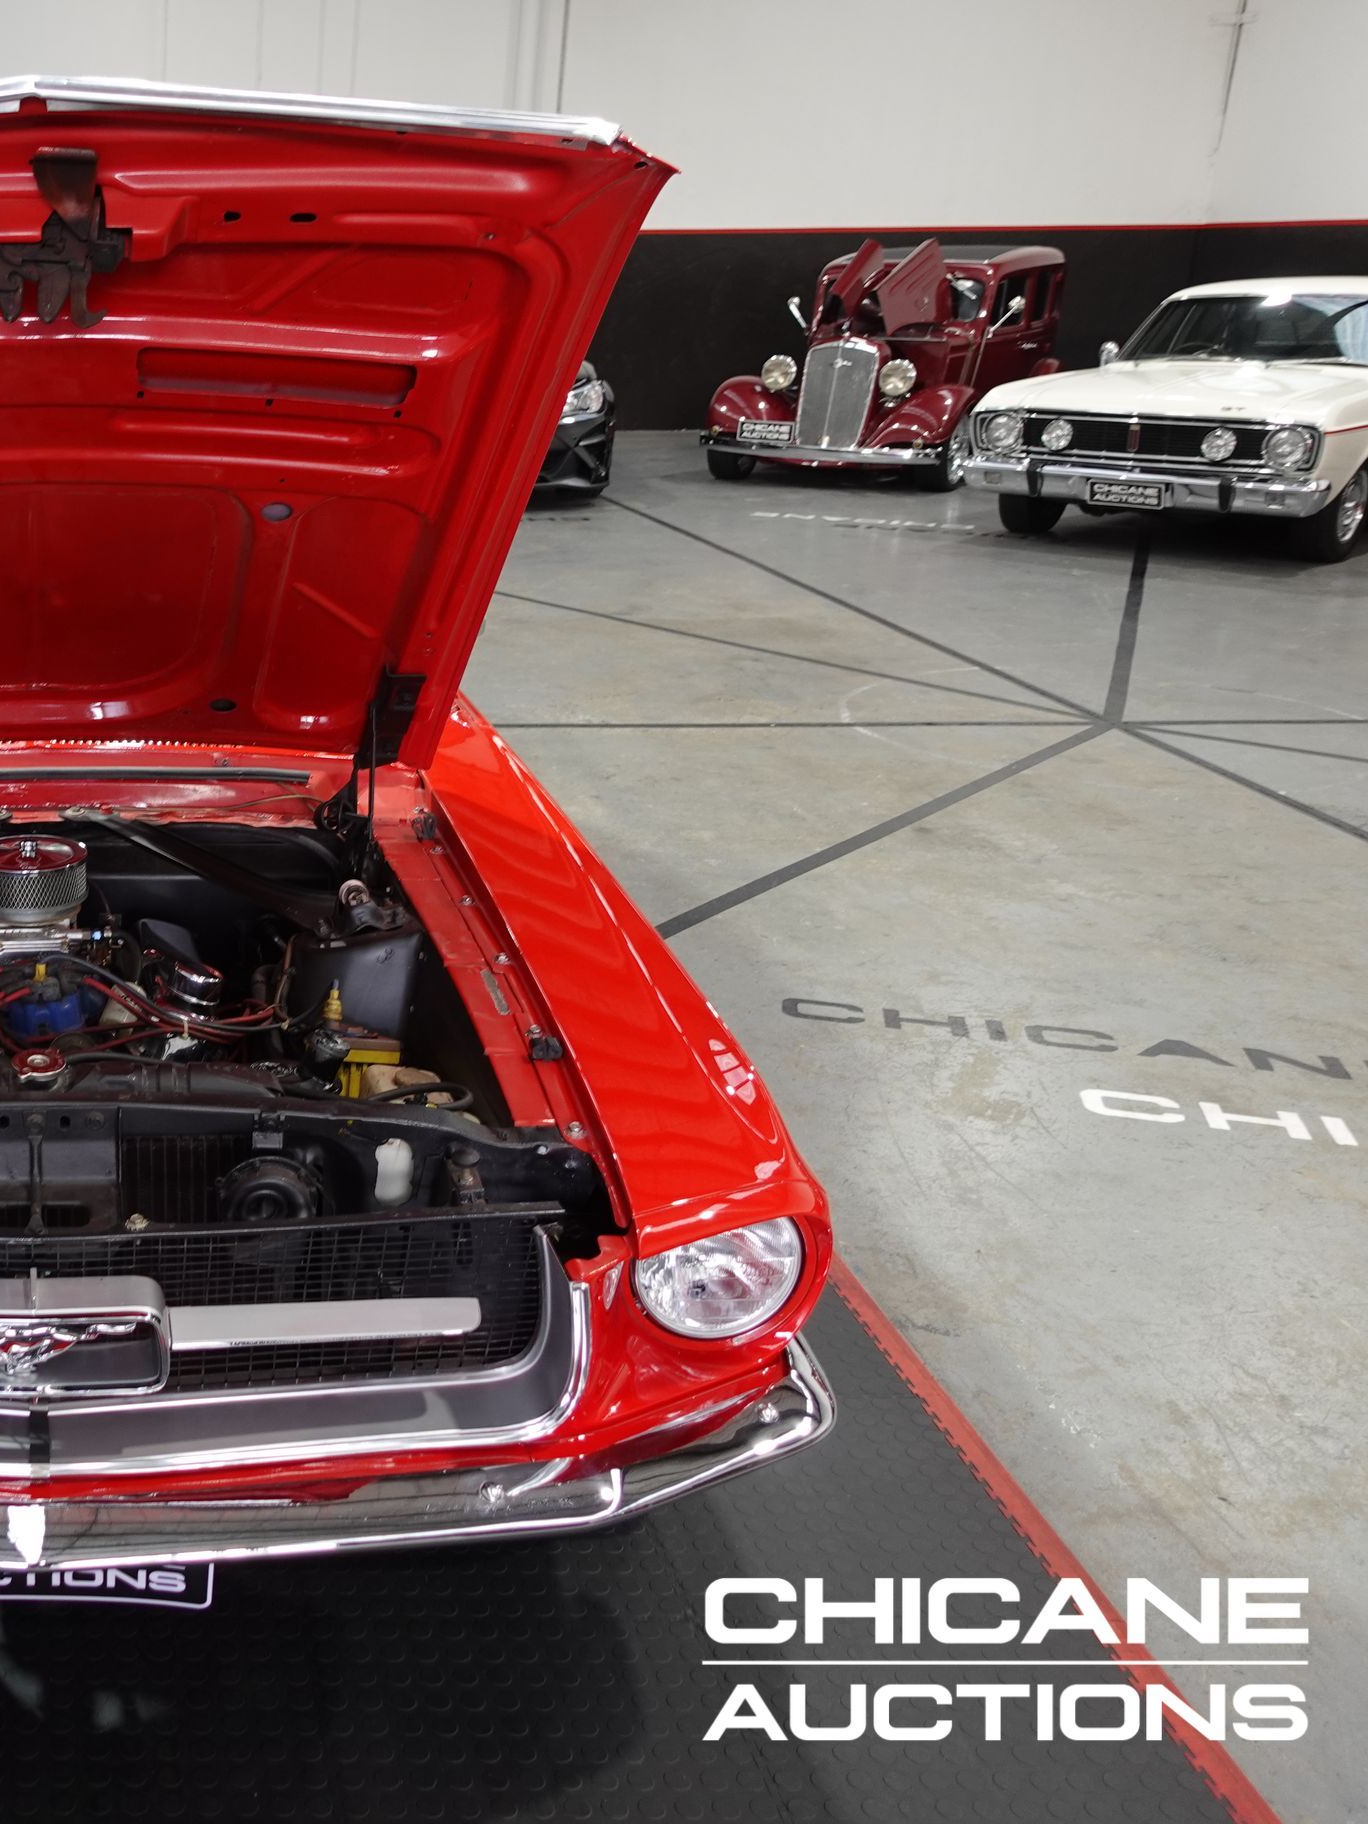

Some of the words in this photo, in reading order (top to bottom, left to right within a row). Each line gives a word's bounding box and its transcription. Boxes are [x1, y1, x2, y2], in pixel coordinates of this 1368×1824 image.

[1093, 483, 1159, 496] CHICANE
[1092, 493, 1158, 505] AUCTIONS
[781, 997, 1368, 1080] CHICAN
